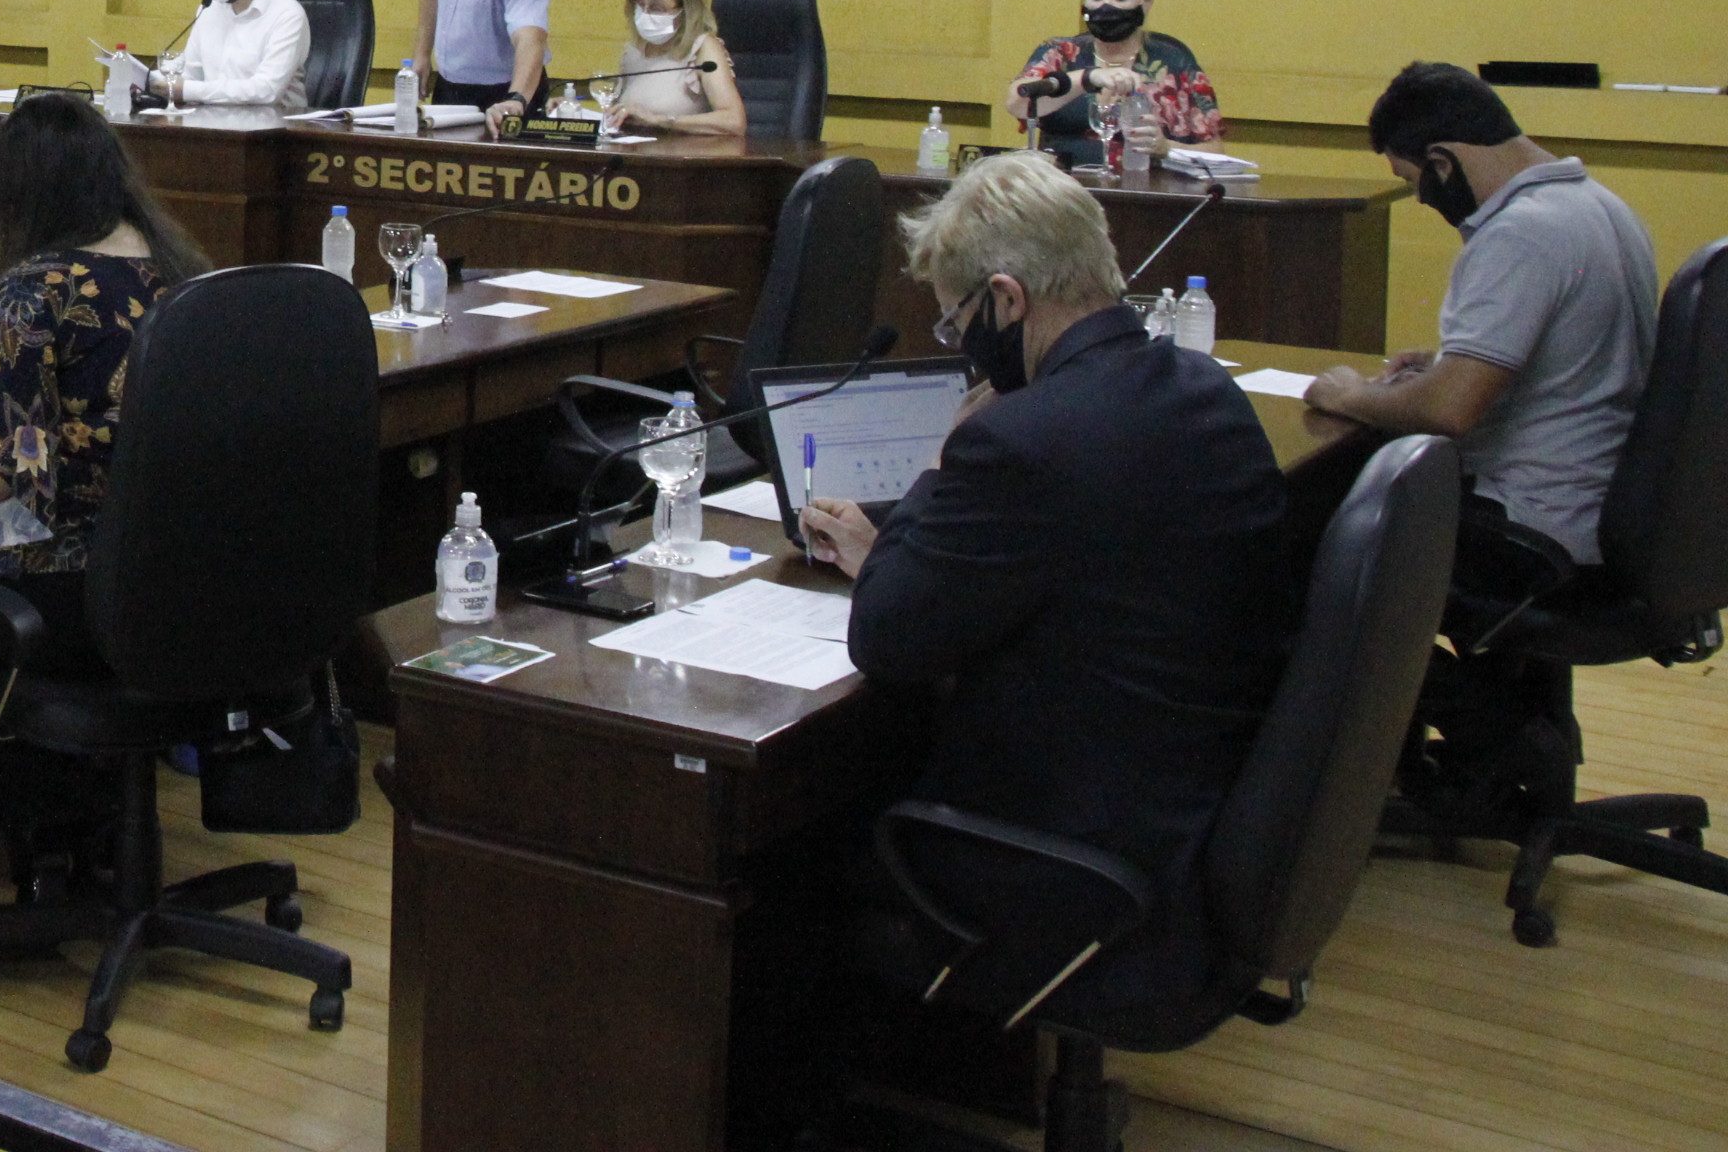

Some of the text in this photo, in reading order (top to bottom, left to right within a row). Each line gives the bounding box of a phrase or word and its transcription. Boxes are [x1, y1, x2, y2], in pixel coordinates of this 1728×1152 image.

[527, 120, 595, 132] NORMA PEREIRA
[353, 156, 641, 210] SECRETÁRIO
